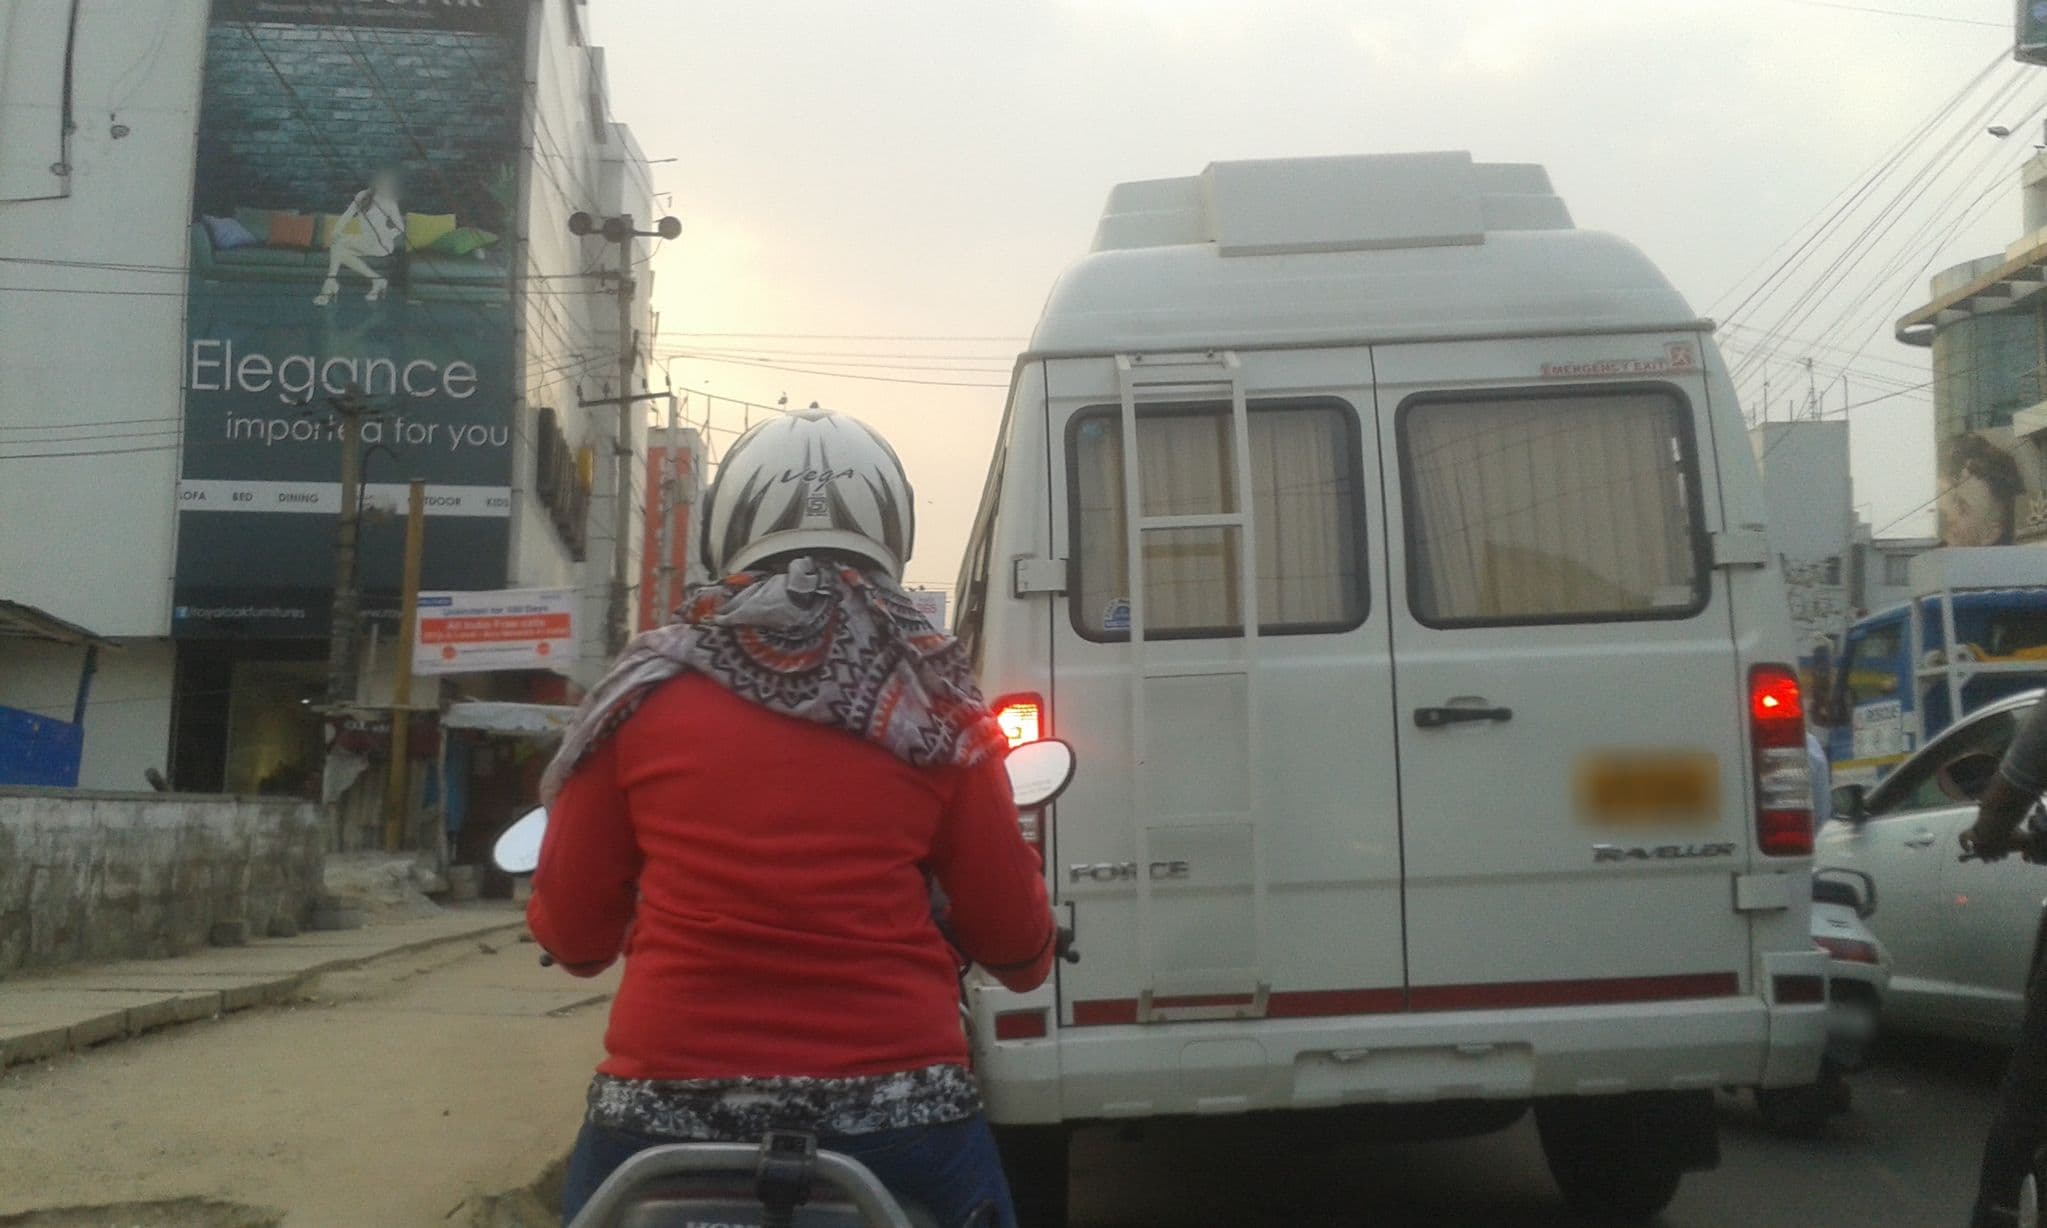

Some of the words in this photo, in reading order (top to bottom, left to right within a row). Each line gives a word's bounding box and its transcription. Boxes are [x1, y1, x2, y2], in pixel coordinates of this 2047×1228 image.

[191, 339, 478, 405] Elegance
[395, 416, 439, 444] for
[449, 424, 509, 451] you
[178, 490, 207, 502] OFA
[278, 493, 319, 504] DINING
